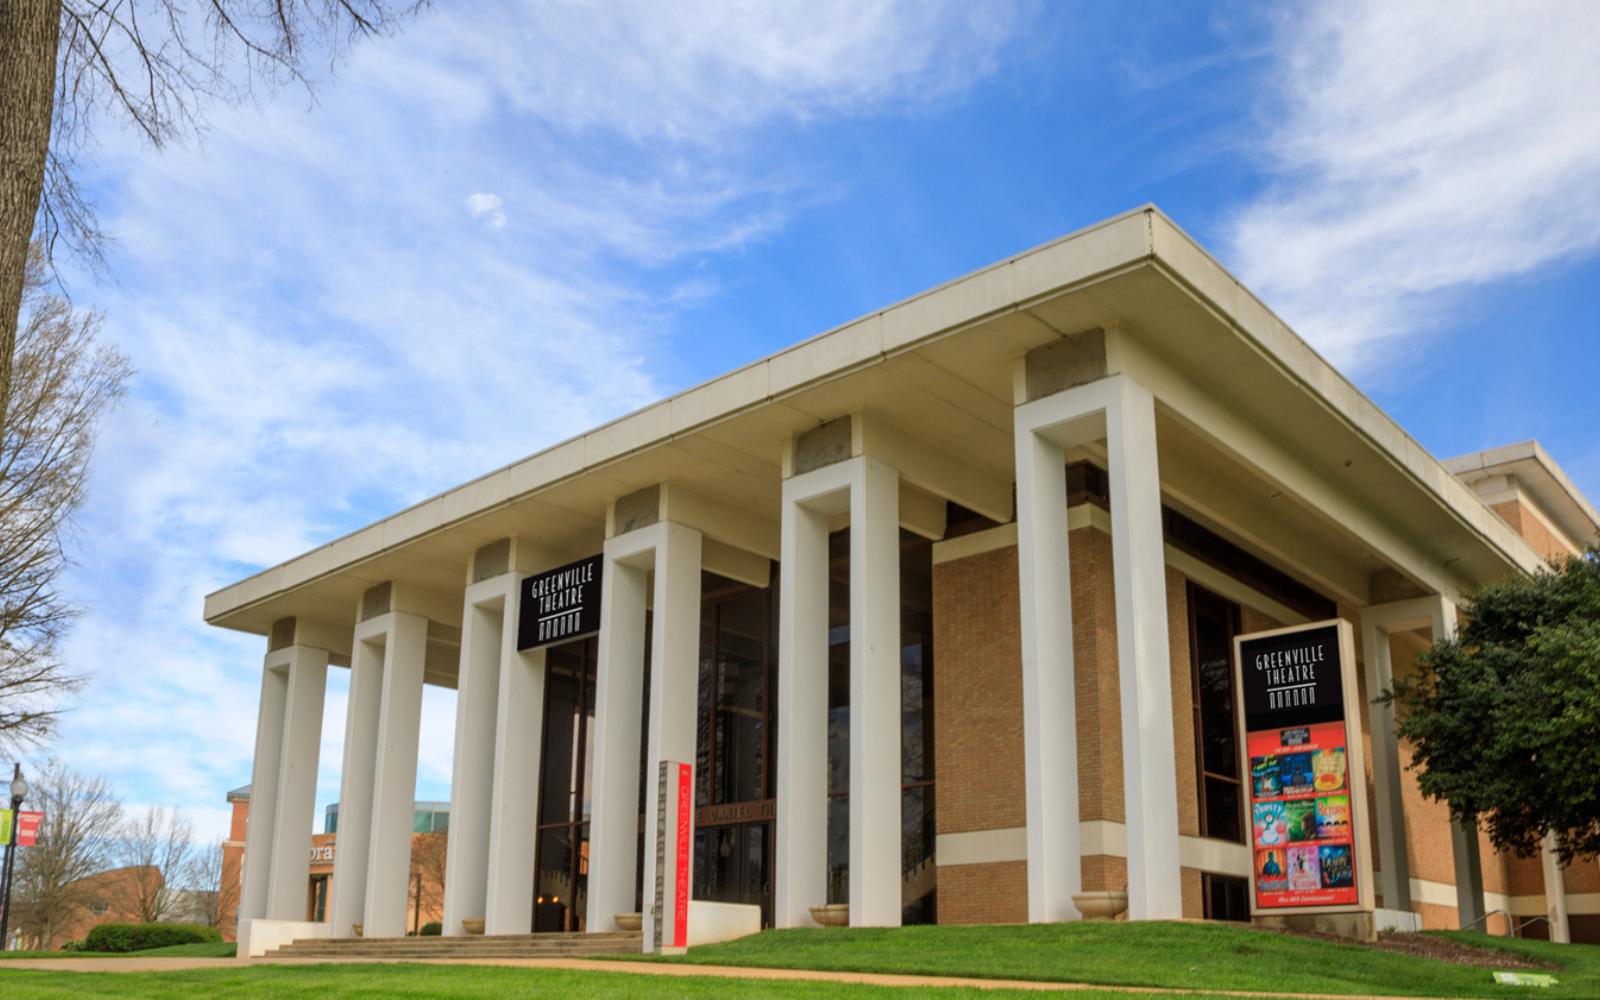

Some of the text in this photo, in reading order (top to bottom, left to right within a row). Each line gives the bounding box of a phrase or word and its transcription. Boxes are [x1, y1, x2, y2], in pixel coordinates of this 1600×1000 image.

[531, 563, 594, 598] GREENVILLE
[539, 585, 584, 614] THEATRE
[1255, 645, 1325, 671] GREENVILLE
[1266, 663, 1316, 686] THEATRE
[678, 785, 689, 863] GREENVILLE
[711, 803, 753, 821] DANIEL
[676, 866, 688, 920] THEATRE
